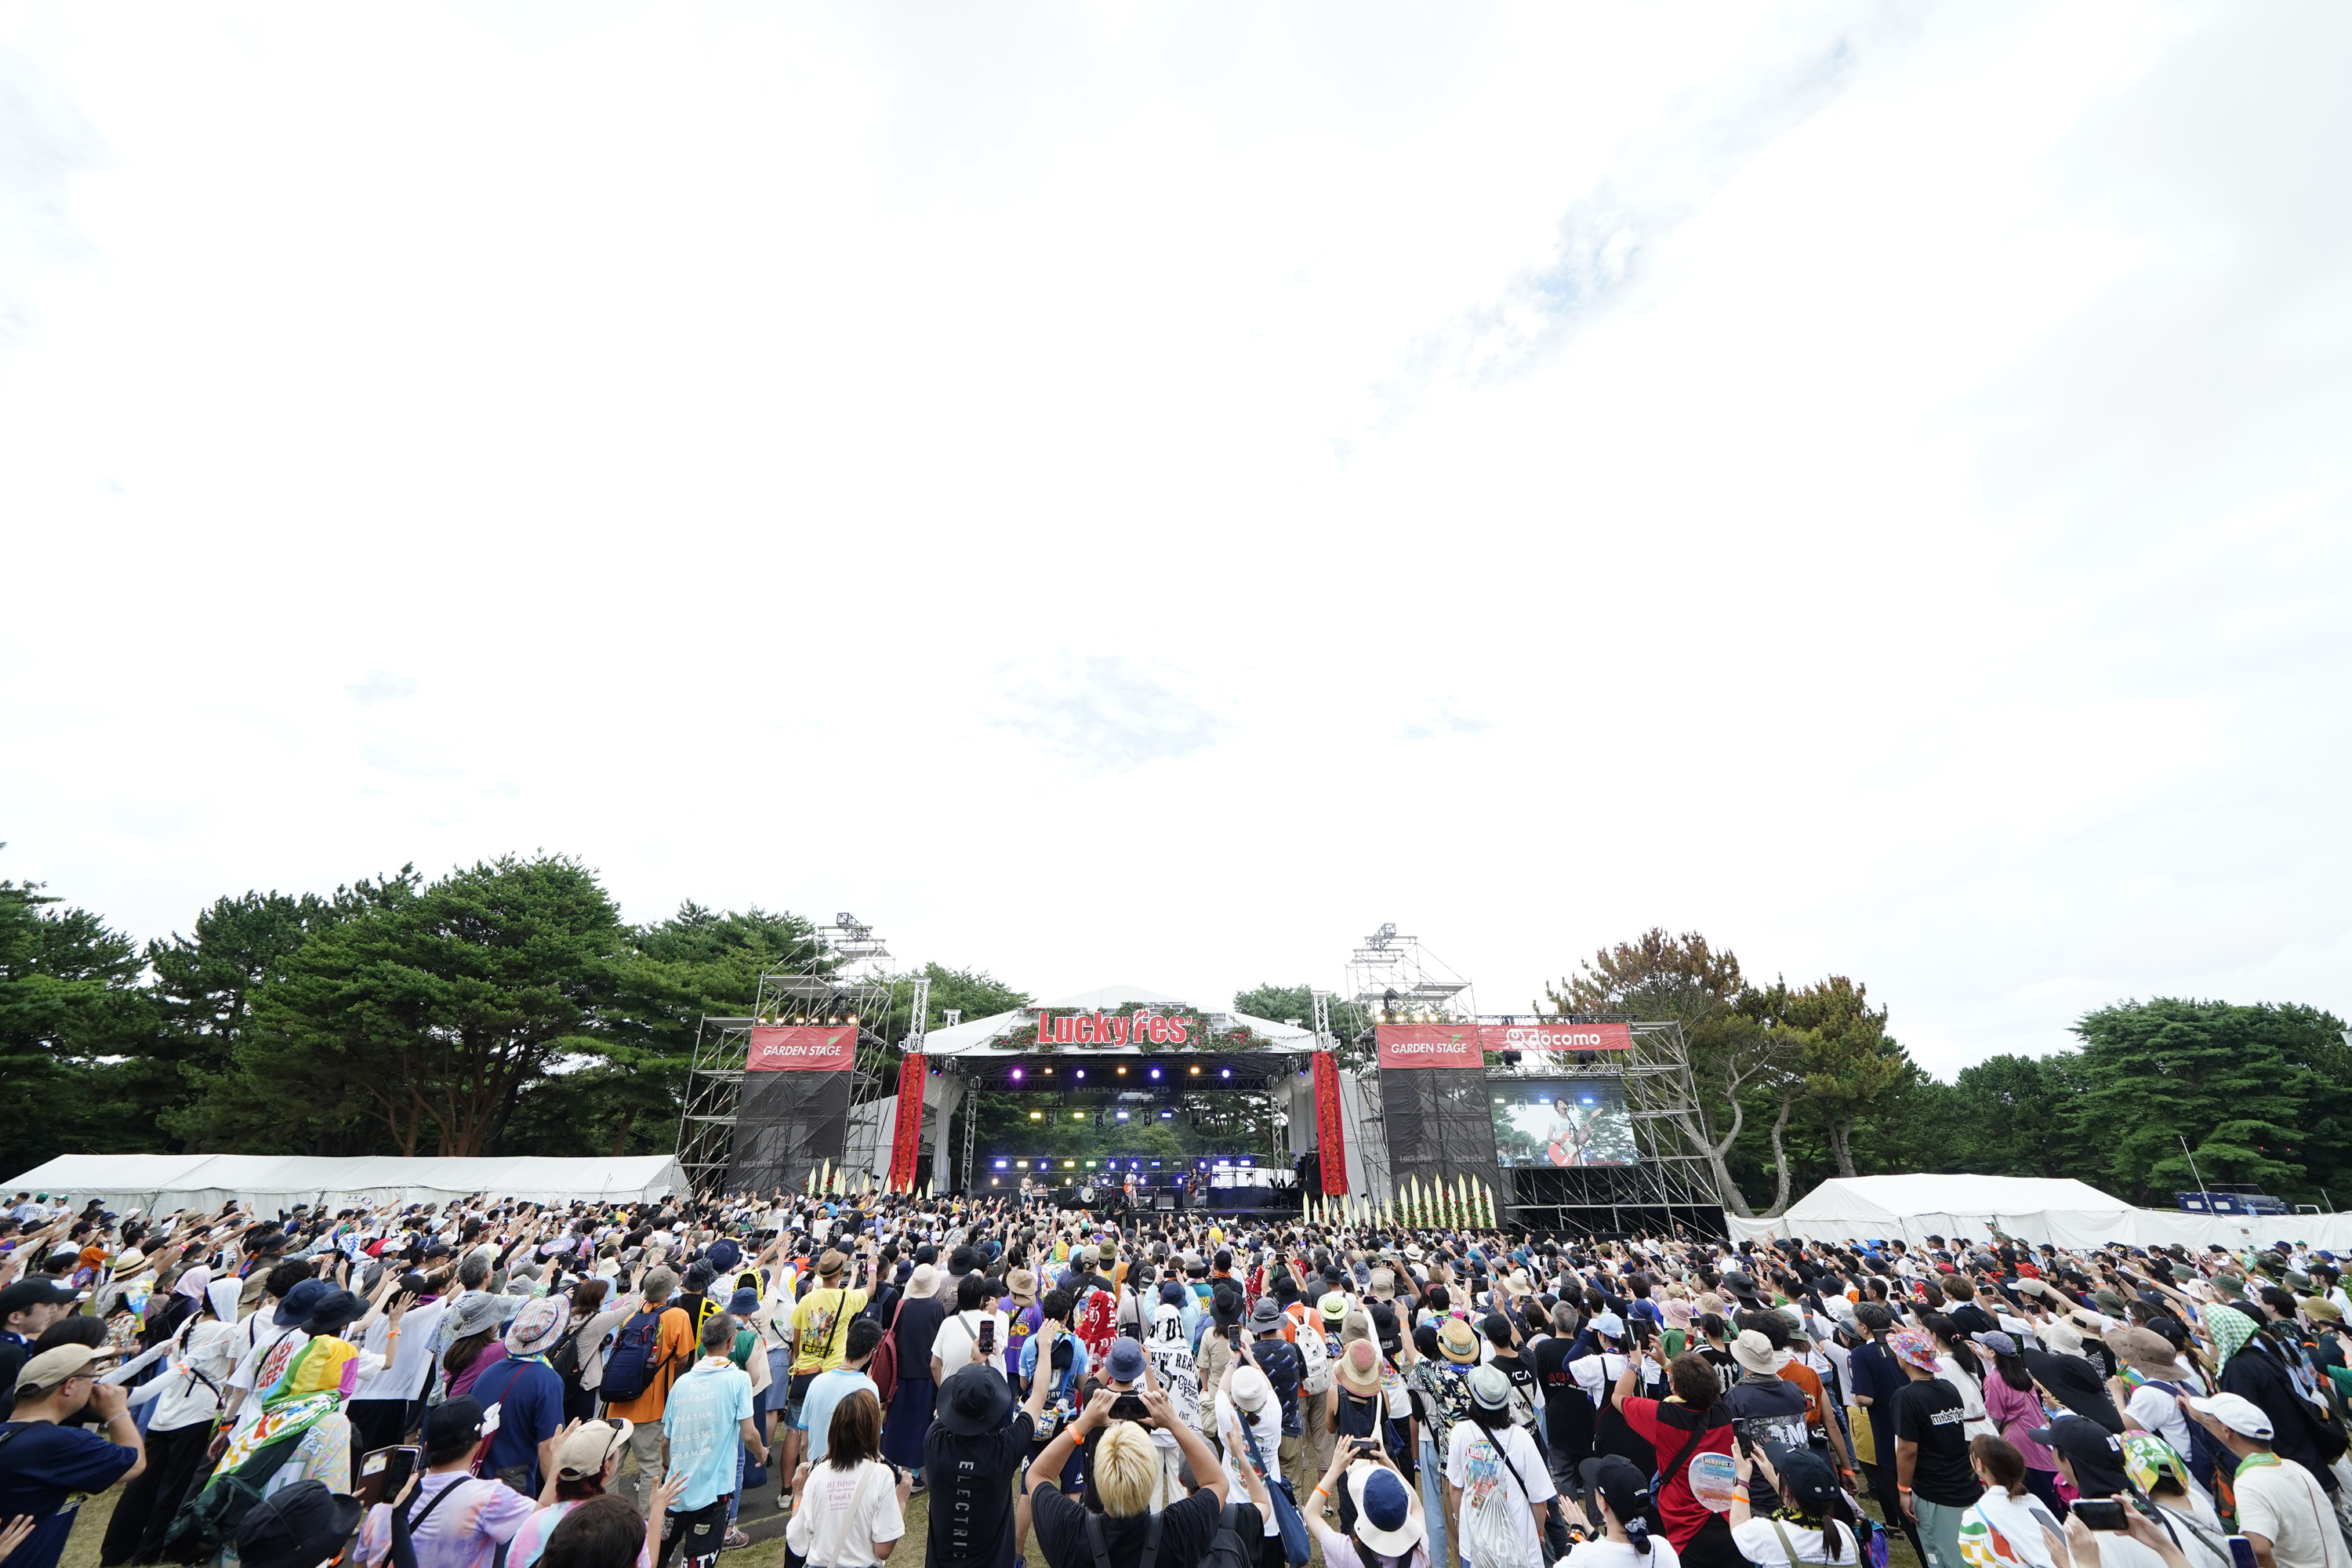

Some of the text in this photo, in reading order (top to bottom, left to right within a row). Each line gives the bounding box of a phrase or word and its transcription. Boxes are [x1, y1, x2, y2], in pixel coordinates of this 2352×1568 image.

[1529, 1029, 1600, 1046] docomo
[763, 1045, 842, 1056] GARDEN STAGE
[1391, 1042, 1467, 1054] GARDEN STAGE
[689, 1381, 710, 1390] ROCK
[953, 1461, 975, 1559] ELECTRIC
